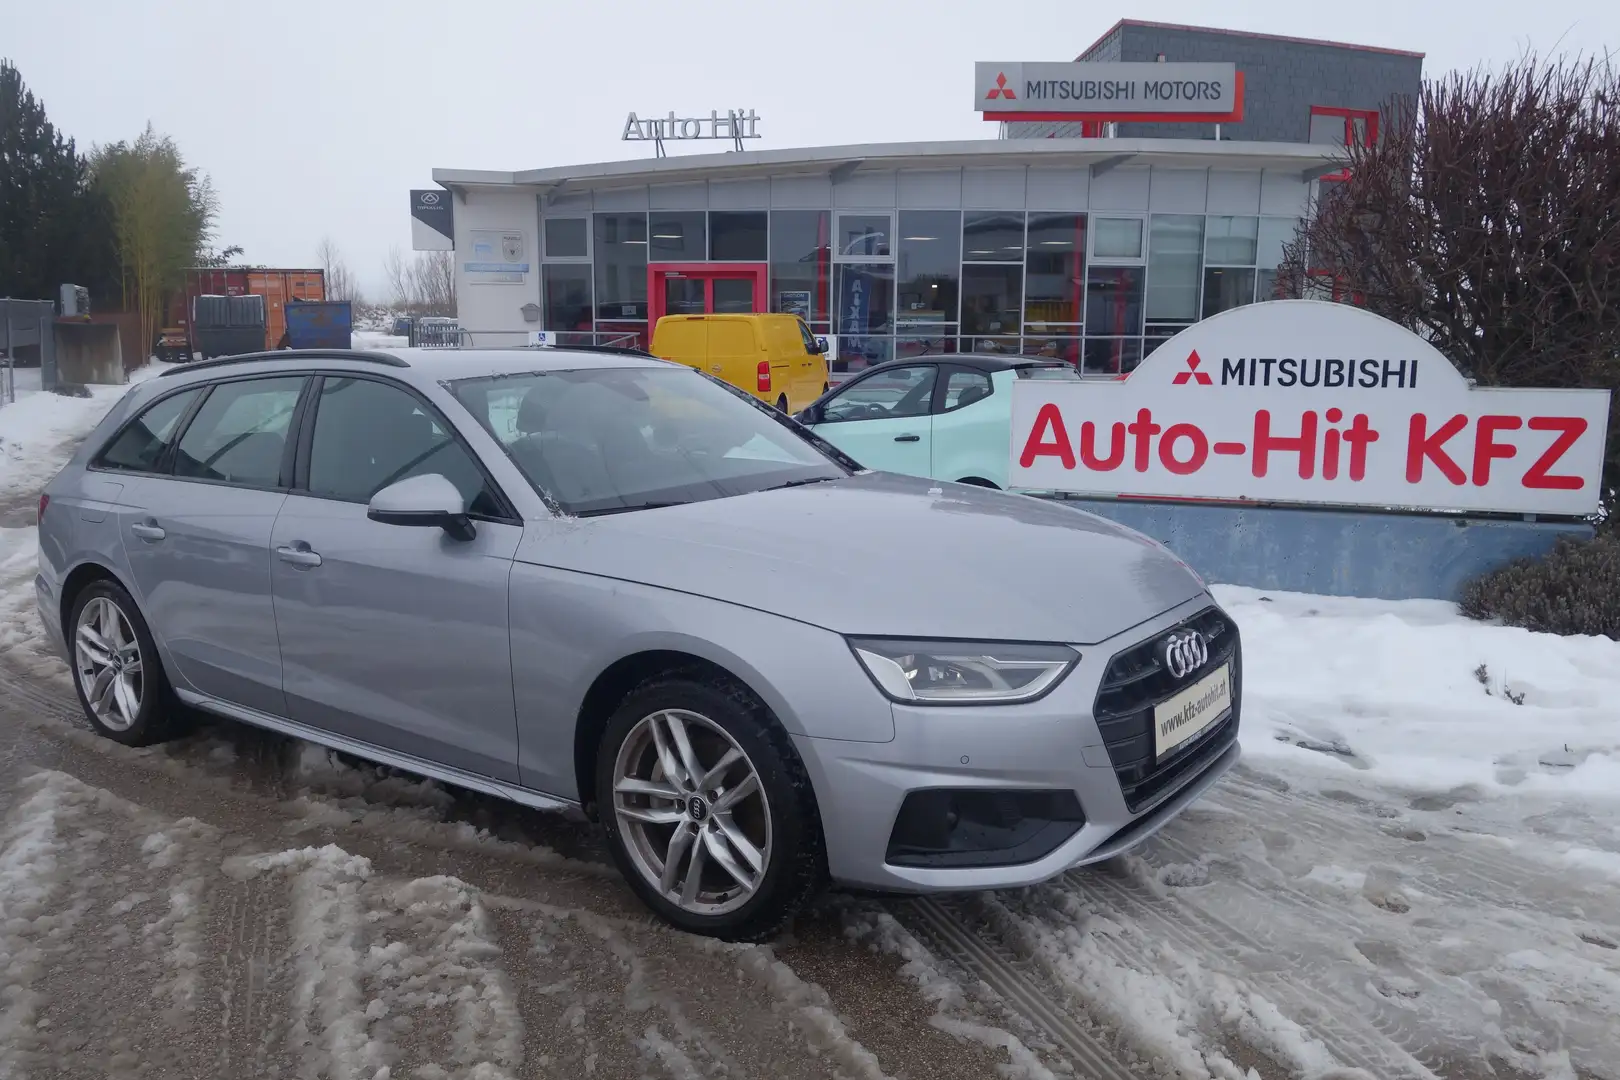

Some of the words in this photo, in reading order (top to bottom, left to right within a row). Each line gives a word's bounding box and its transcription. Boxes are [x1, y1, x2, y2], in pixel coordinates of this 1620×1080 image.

[1026, 80, 1135, 100] MITSUBISHI
[1144, 81, 1221, 101] MOTORS
[621, 110, 700, 141] Auto
[711, 108, 761, 139] Hit
[848, 279, 863, 349] AIXAM
[1220, 357, 1418, 389] MITSUBISHI
[1019, 402, 1379, 482] Auto-Hit
[1405, 412, 1588, 490] KFZ
[1160, 680, 1227, 737] www.kfz-autohit.at
